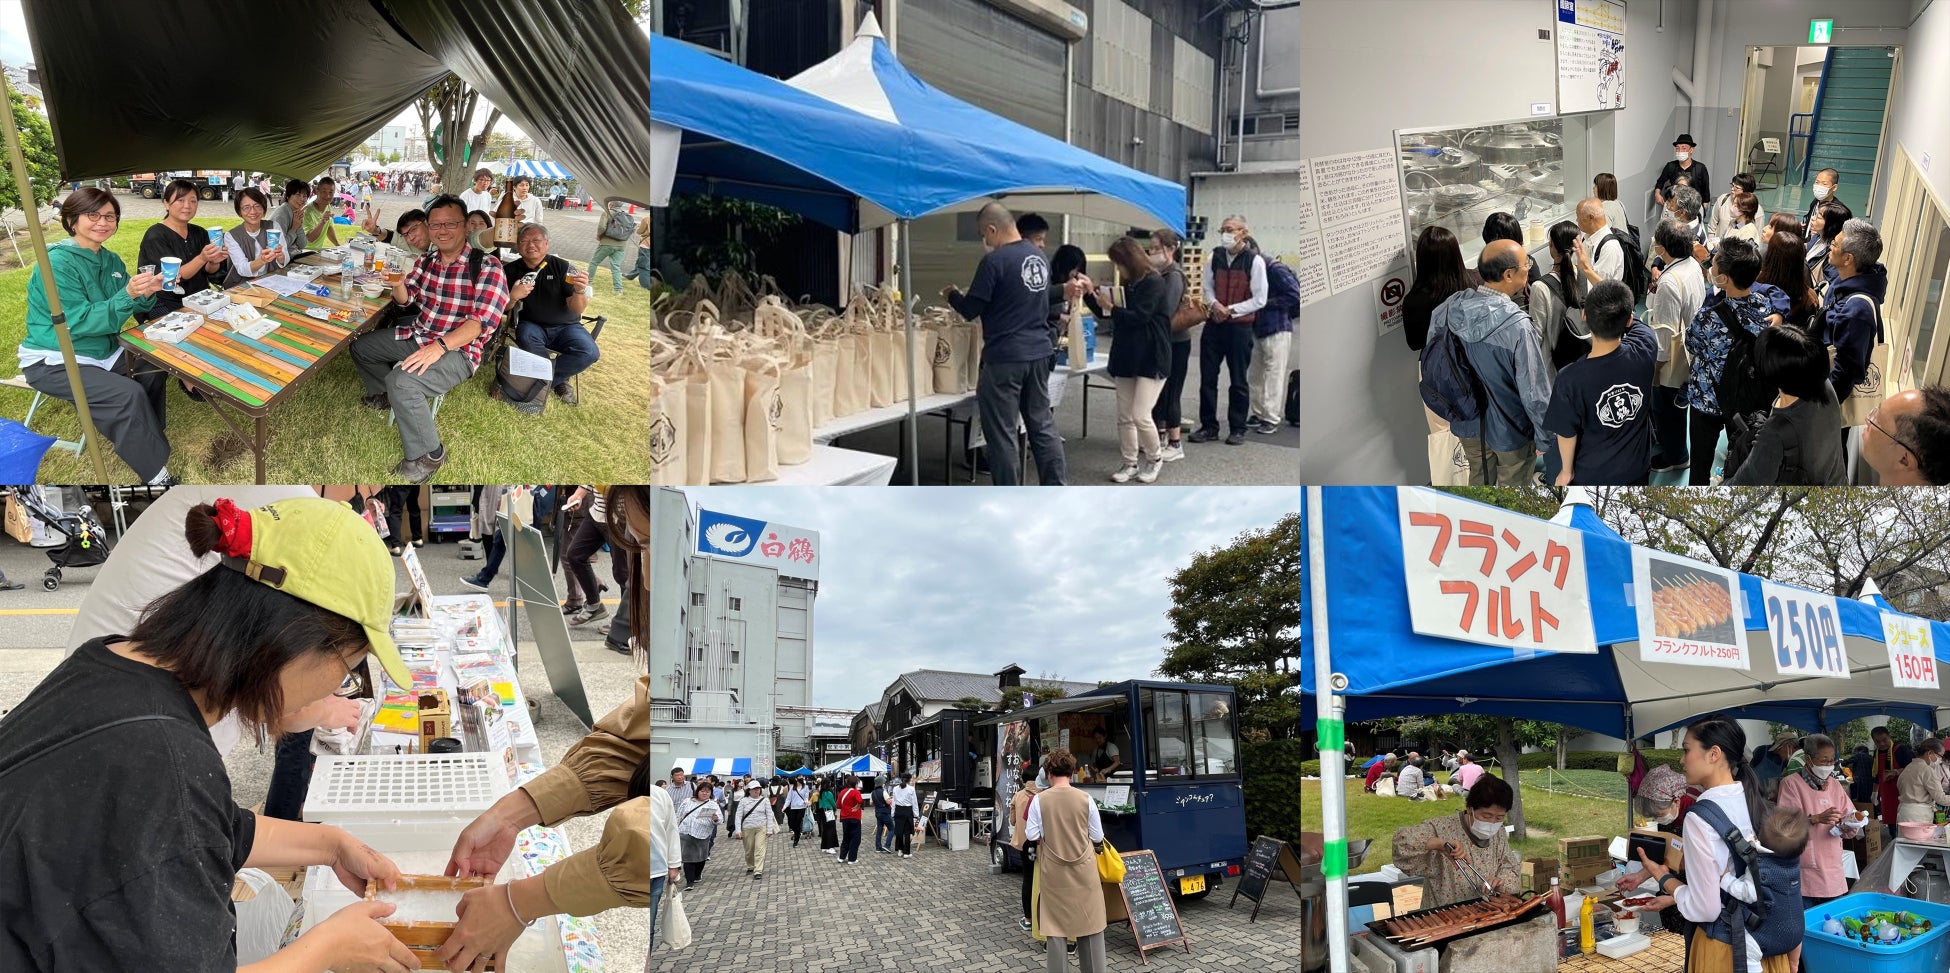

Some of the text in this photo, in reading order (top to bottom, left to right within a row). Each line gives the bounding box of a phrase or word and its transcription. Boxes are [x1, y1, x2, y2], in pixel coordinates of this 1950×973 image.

[1381, 305, 1403, 321] 撮影禁
[761, 532, 815, 564] 白鶴
[1409, 511, 1570, 590] フランク
[1440, 580, 1560, 643] フルト
[1768, 595, 1843, 673] 250円
[1888, 622, 1931, 648] ジュース
[1653, 639, 1740, 661] フランクフルト250円
[1895, 653, 1935, 682] 150円
[1012, 753, 1020, 793] おなか
[1190, 881, 1205, 892] 476
